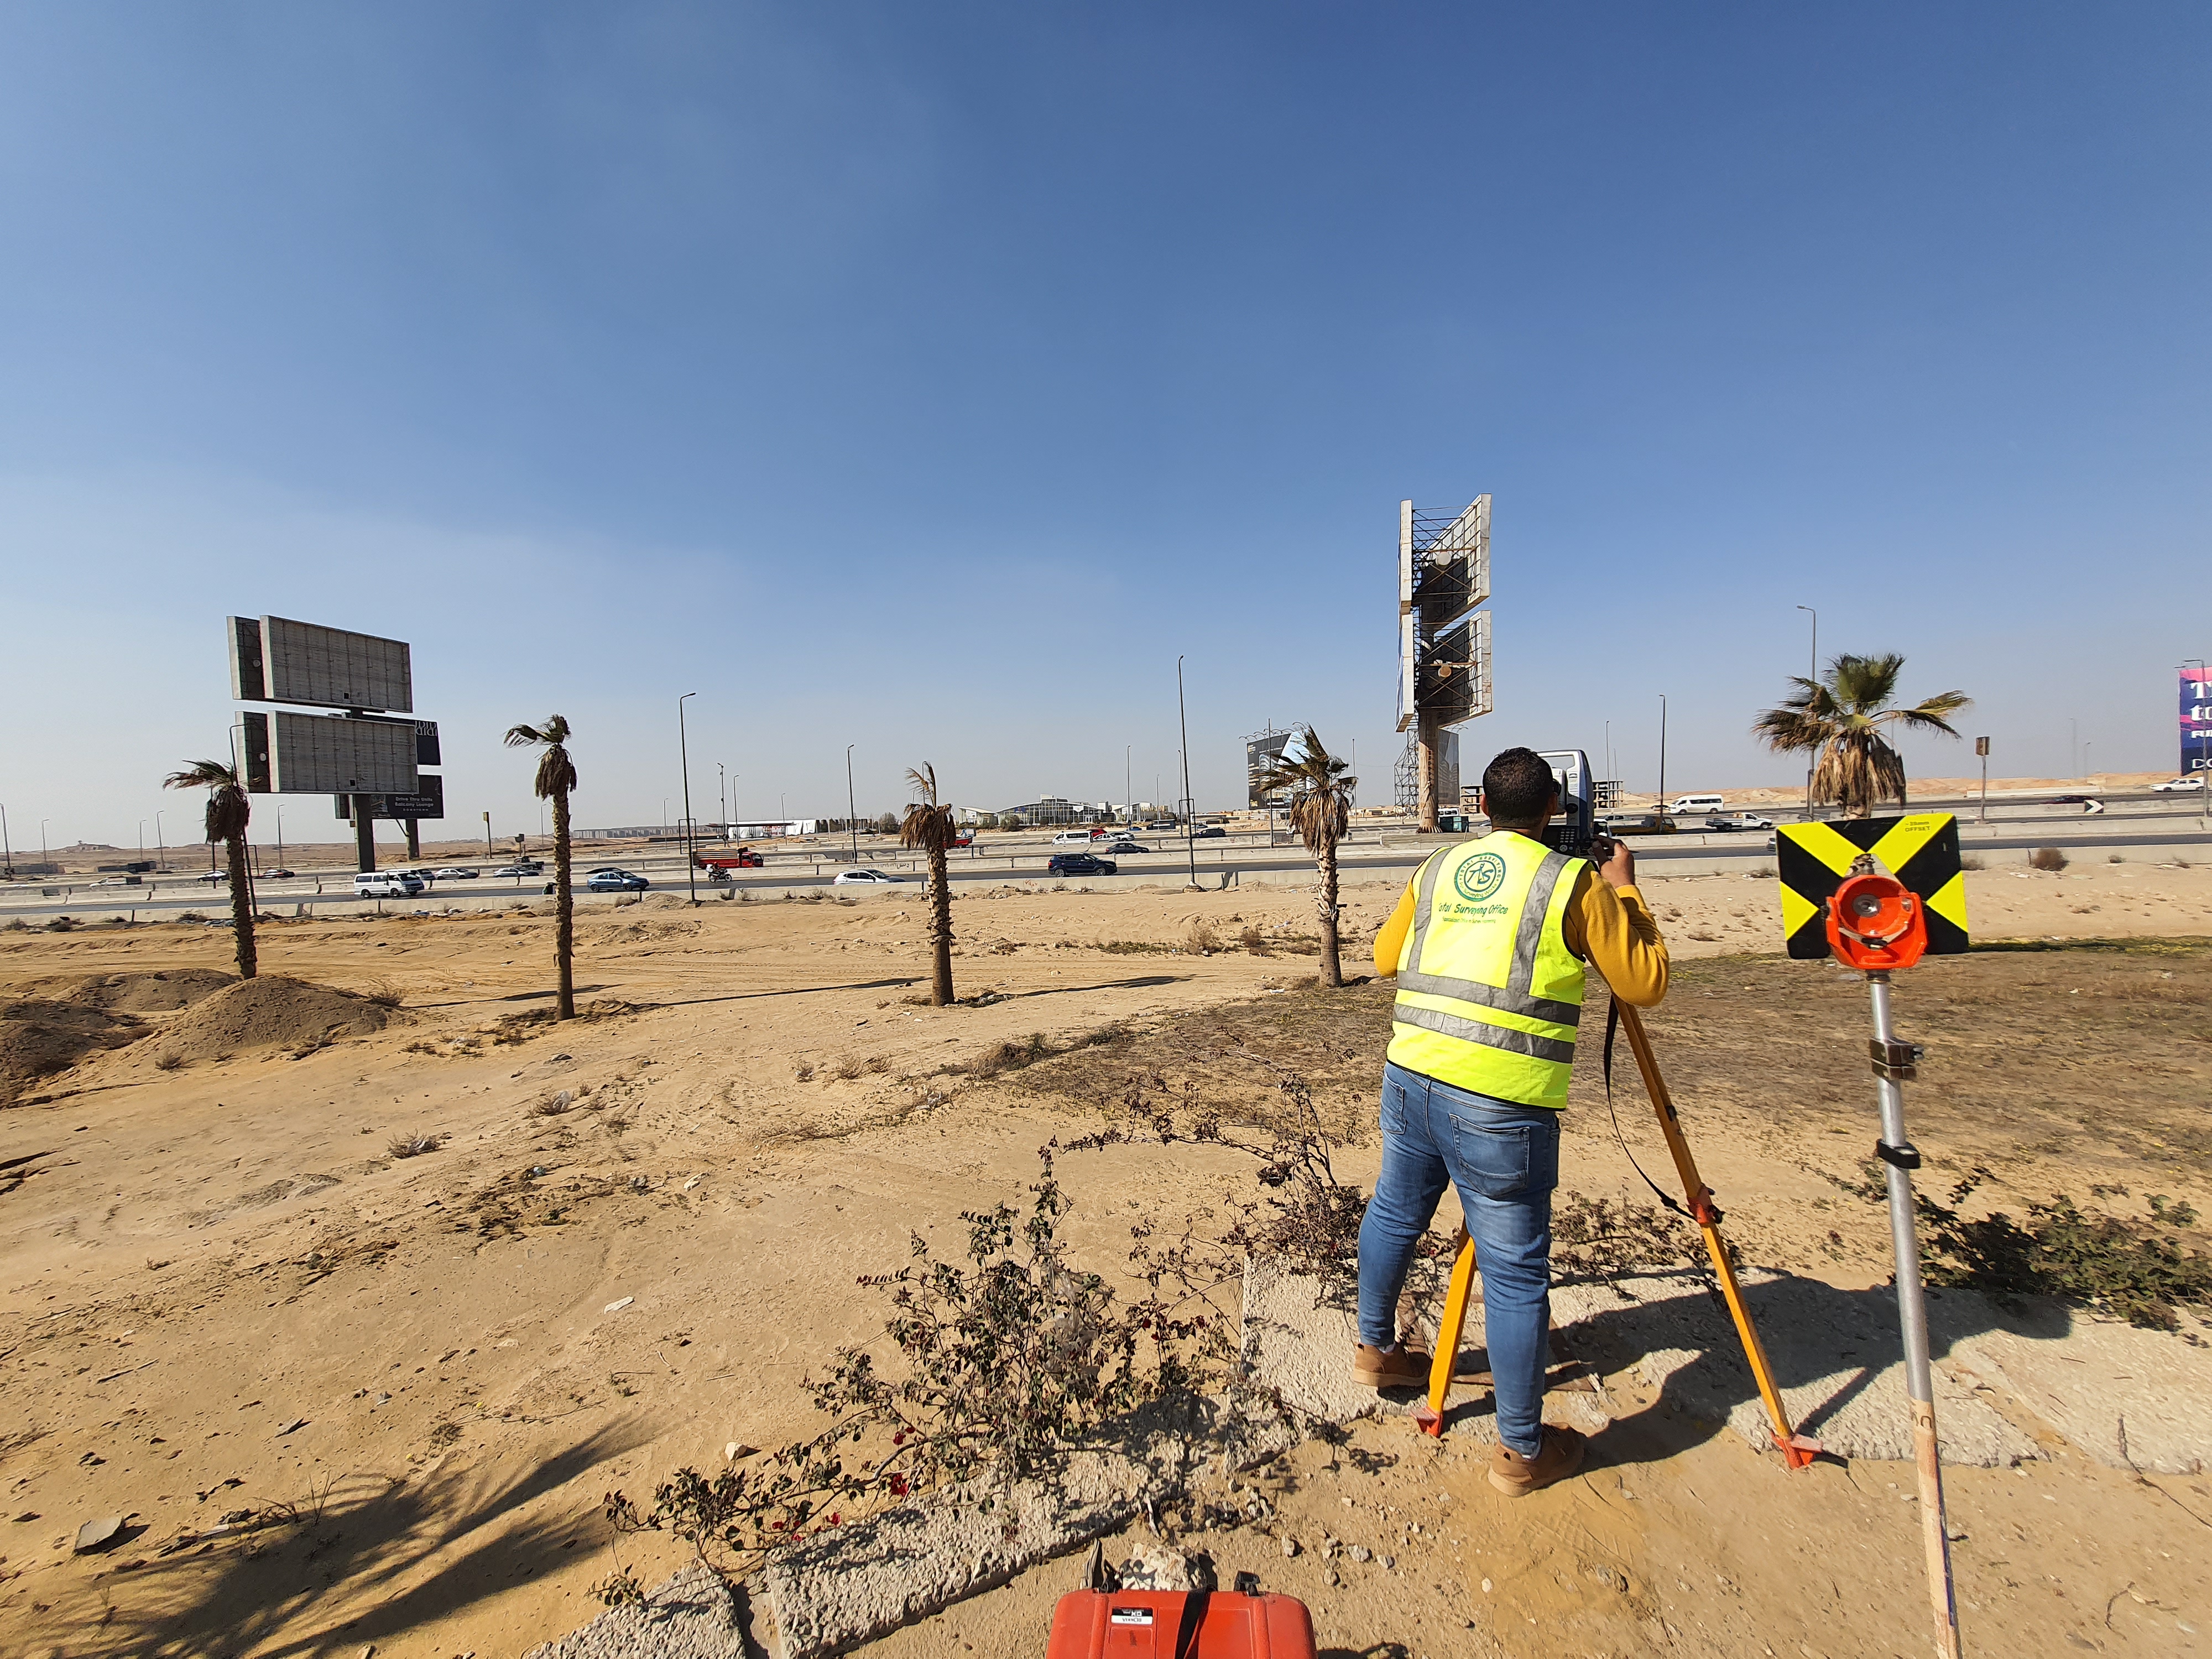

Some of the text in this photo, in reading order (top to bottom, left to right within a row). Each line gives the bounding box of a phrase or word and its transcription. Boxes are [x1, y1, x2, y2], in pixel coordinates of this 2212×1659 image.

[2190, 681, 2212, 699] T
[1438, 902, 1509, 917] otal Surveying Office
